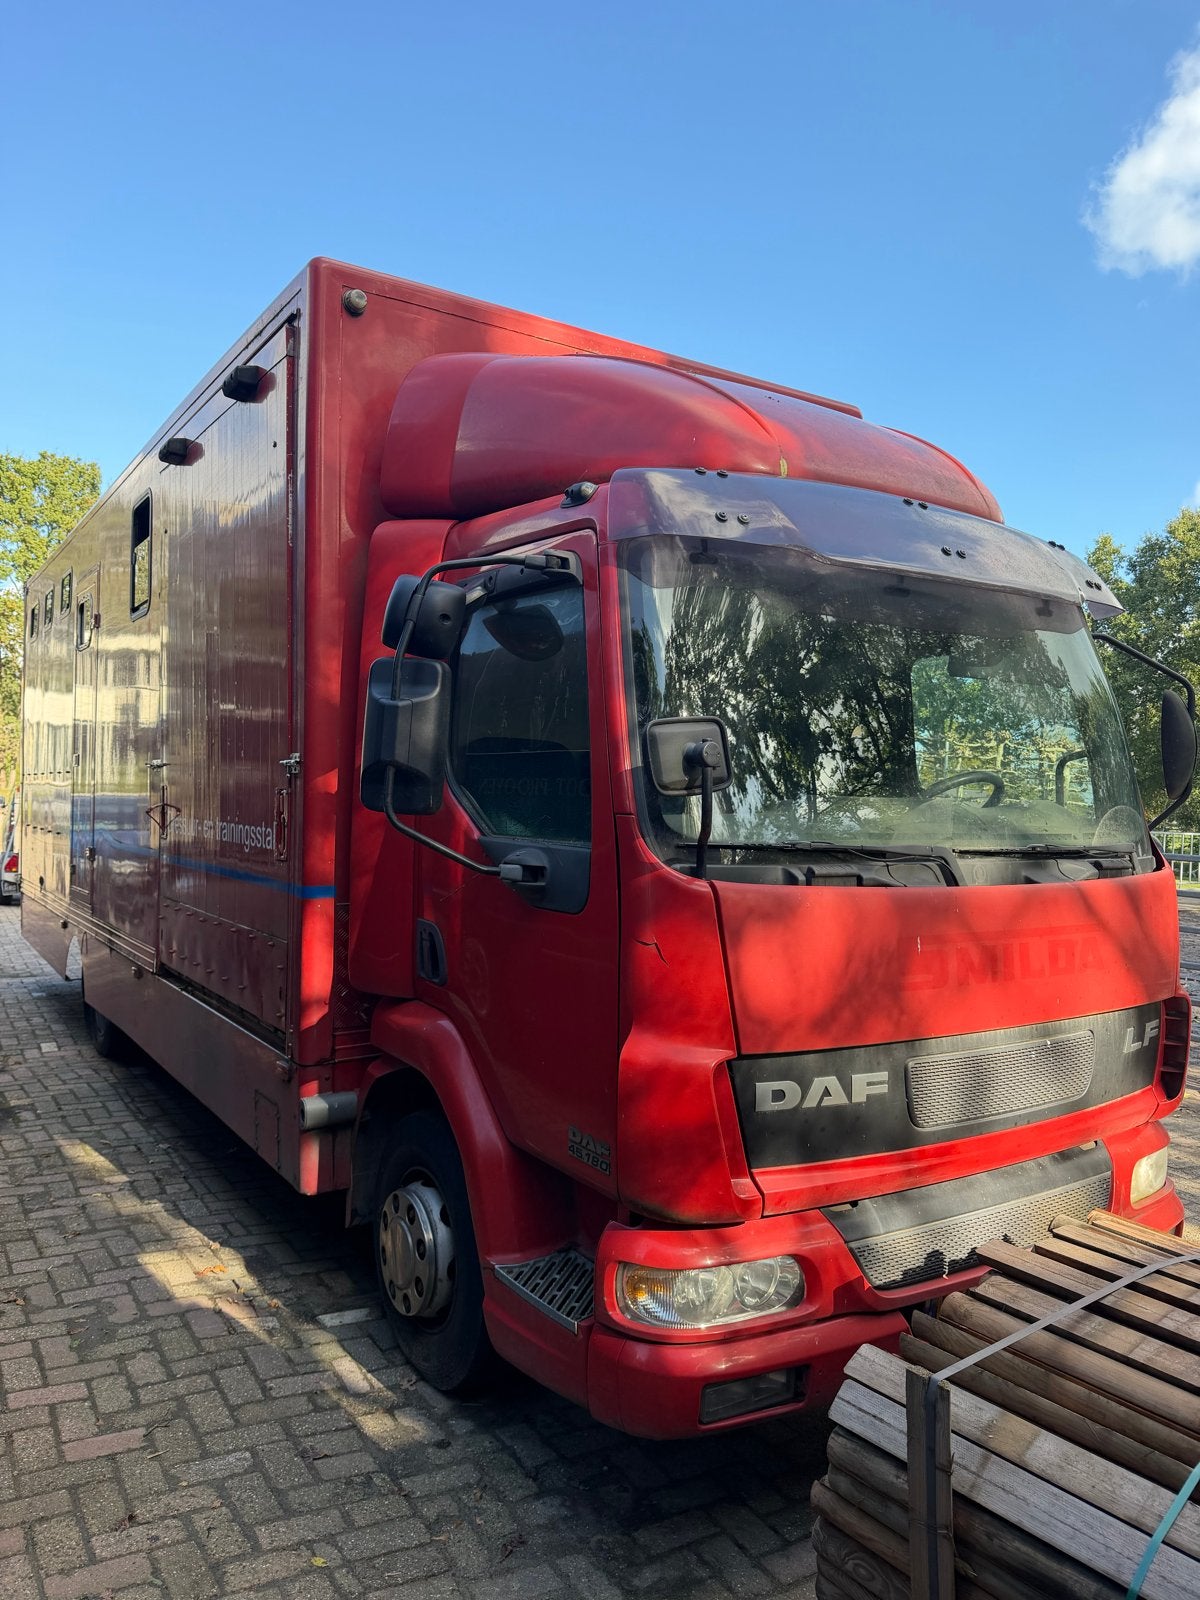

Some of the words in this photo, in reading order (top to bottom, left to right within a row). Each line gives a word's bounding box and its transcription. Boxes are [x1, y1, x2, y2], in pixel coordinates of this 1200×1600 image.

[1123, 1019, 1160, 1053] LF
[756, 1071, 889, 1112] DAF
[568, 1143, 610, 1173] 45.180
